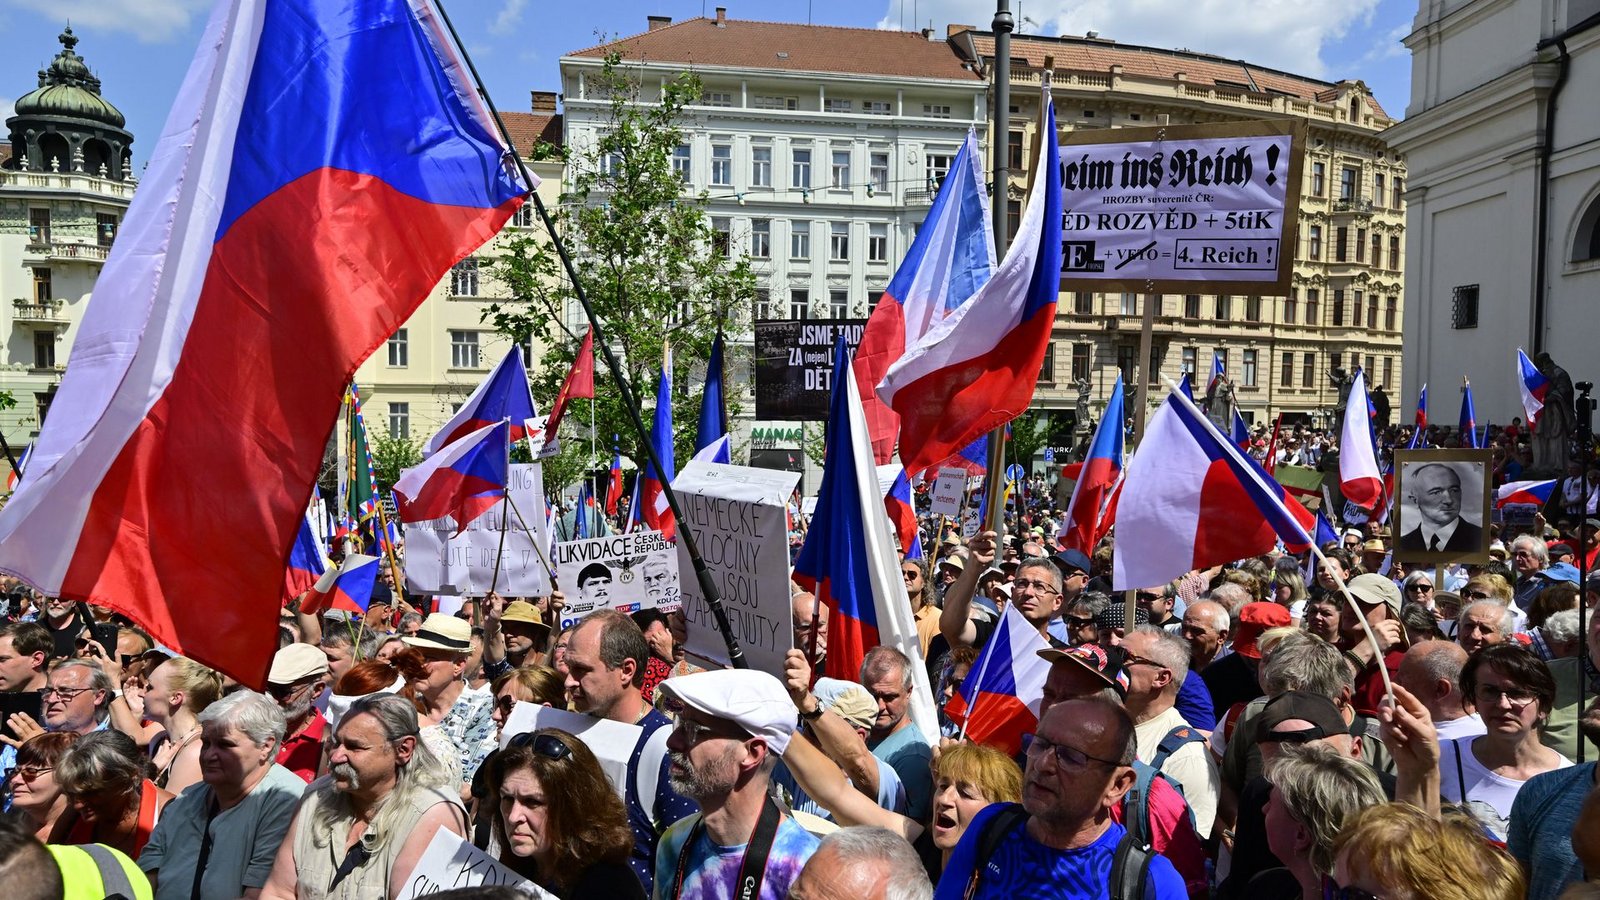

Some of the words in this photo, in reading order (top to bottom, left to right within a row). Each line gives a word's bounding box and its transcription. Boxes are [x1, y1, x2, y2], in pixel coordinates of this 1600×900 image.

[1119, 151, 1164, 190] ins
[1168, 145, 1254, 189] Reich
[1102, 194, 1146, 205] HROZBY
[1147, 194, 1193, 204] suverenitě
[1195, 192, 1214, 203] ČR:
[1096, 207, 1198, 231] ROZVĚD
[1224, 210, 1275, 230] 5tiK
[1117, 248, 1159, 262] VETO
[1201, 246, 1259, 264] Reich
[798, 325, 834, 345] JSME
[788, 347, 804, 367] ZA
[804, 351, 828, 364] (nejen)
[683, 488, 764, 538] NĚMECKÉ
[558, 537, 632, 564] LIKVIDACE
[692, 529, 761, 575] ZLOČINY
